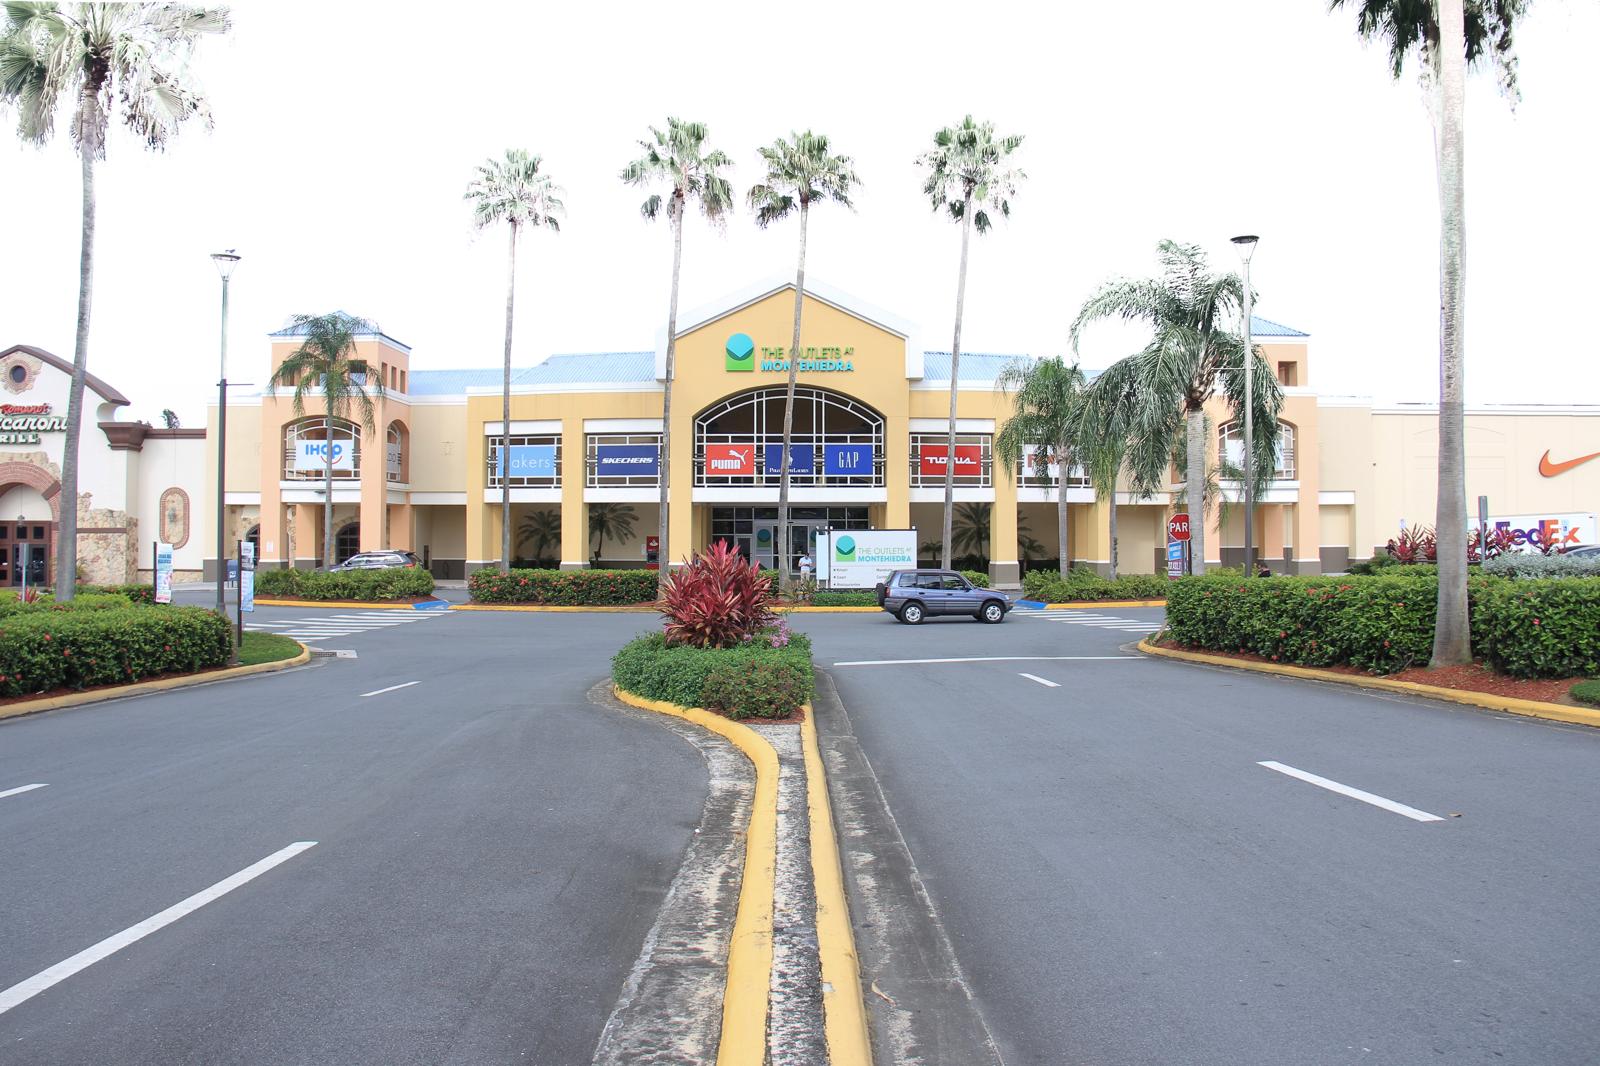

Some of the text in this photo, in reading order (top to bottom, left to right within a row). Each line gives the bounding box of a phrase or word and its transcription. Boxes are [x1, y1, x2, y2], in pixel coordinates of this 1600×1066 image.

[761, 347, 784, 359] THE
[844, 346, 854, 355] AT
[0, 417, 68, 431] caroni
[0, 434, 38, 443] RILL
[511, 454, 551, 469] akers
[711, 459, 741, 469] PUMA
[838, 451, 860, 469] GAP
[1169, 522, 1188, 533] PAR
[1495, 519, 1581, 546] FedEx
[858, 547, 872, 555] THE
[874, 547, 905, 555] OUTLETS
